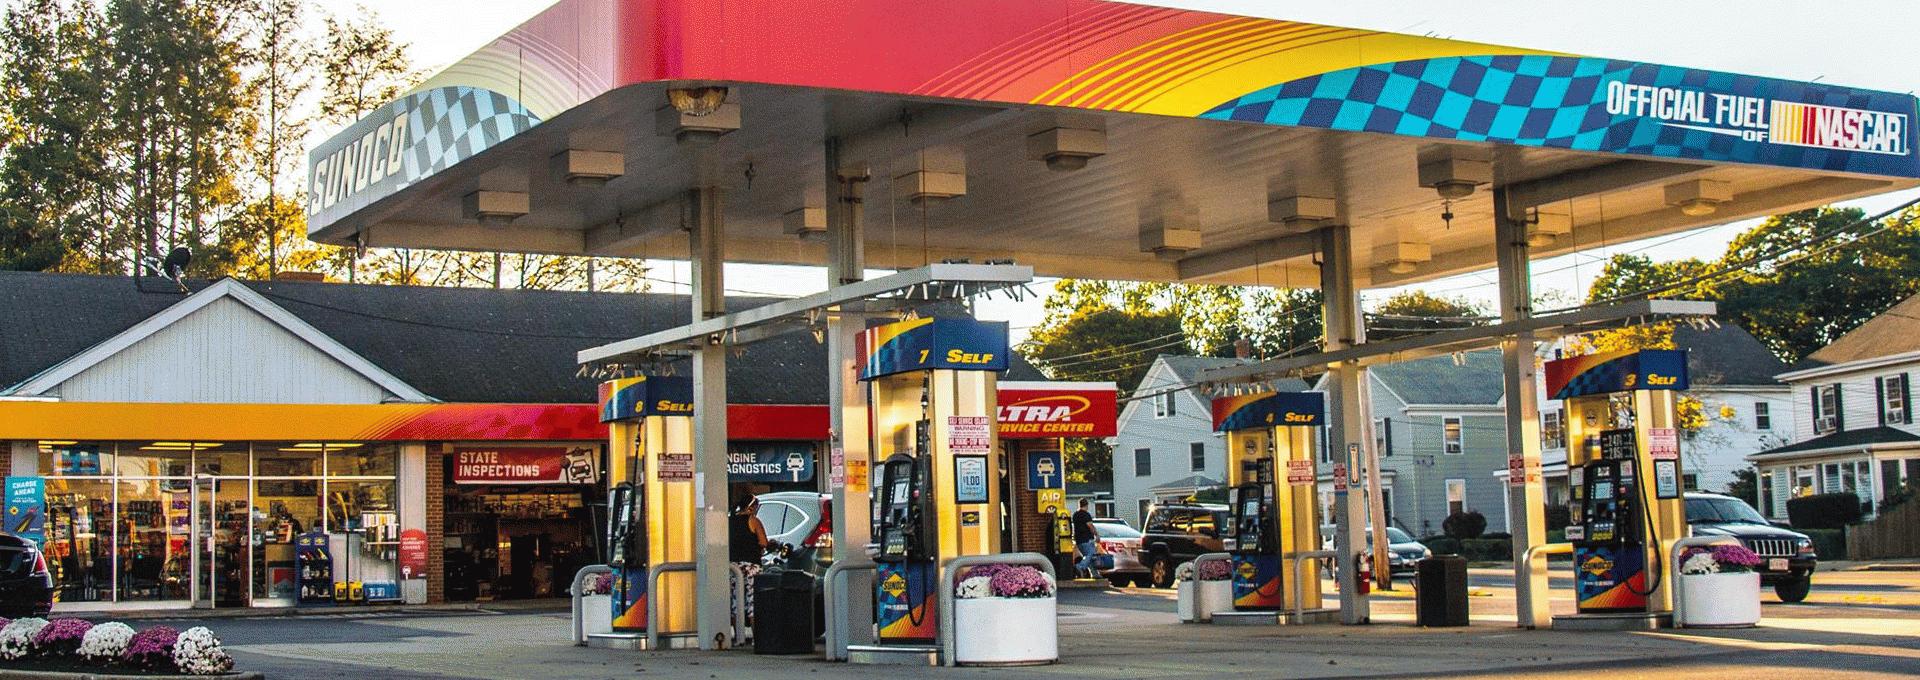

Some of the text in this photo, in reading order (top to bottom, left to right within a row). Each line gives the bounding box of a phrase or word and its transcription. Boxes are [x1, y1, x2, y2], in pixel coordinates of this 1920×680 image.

[1606, 80, 1769, 129] OFFICIAL FUEL
[1814, 106, 1900, 152] NASCAR
[1742, 130, 1768, 142] OF
[310, 111, 408, 216] SUNOCO
[918, 349, 993, 364] 7 SELF
[1624, 373, 1677, 387] 3 SELF
[635, 400, 644, 413] 8
[997, 405, 1071, 422] LTRA
[1265, 411, 1315, 423] 4 SELF
[997, 423, 1094, 433] ERVICE CENTER
[459, 451, 499, 464] STATE
[727, 452, 756, 463] NGINE
[459, 464, 540, 477] INSPECTIONS
[727, 463, 781, 474] AGNOSTICS
[1041, 493, 1060, 501] AIR
